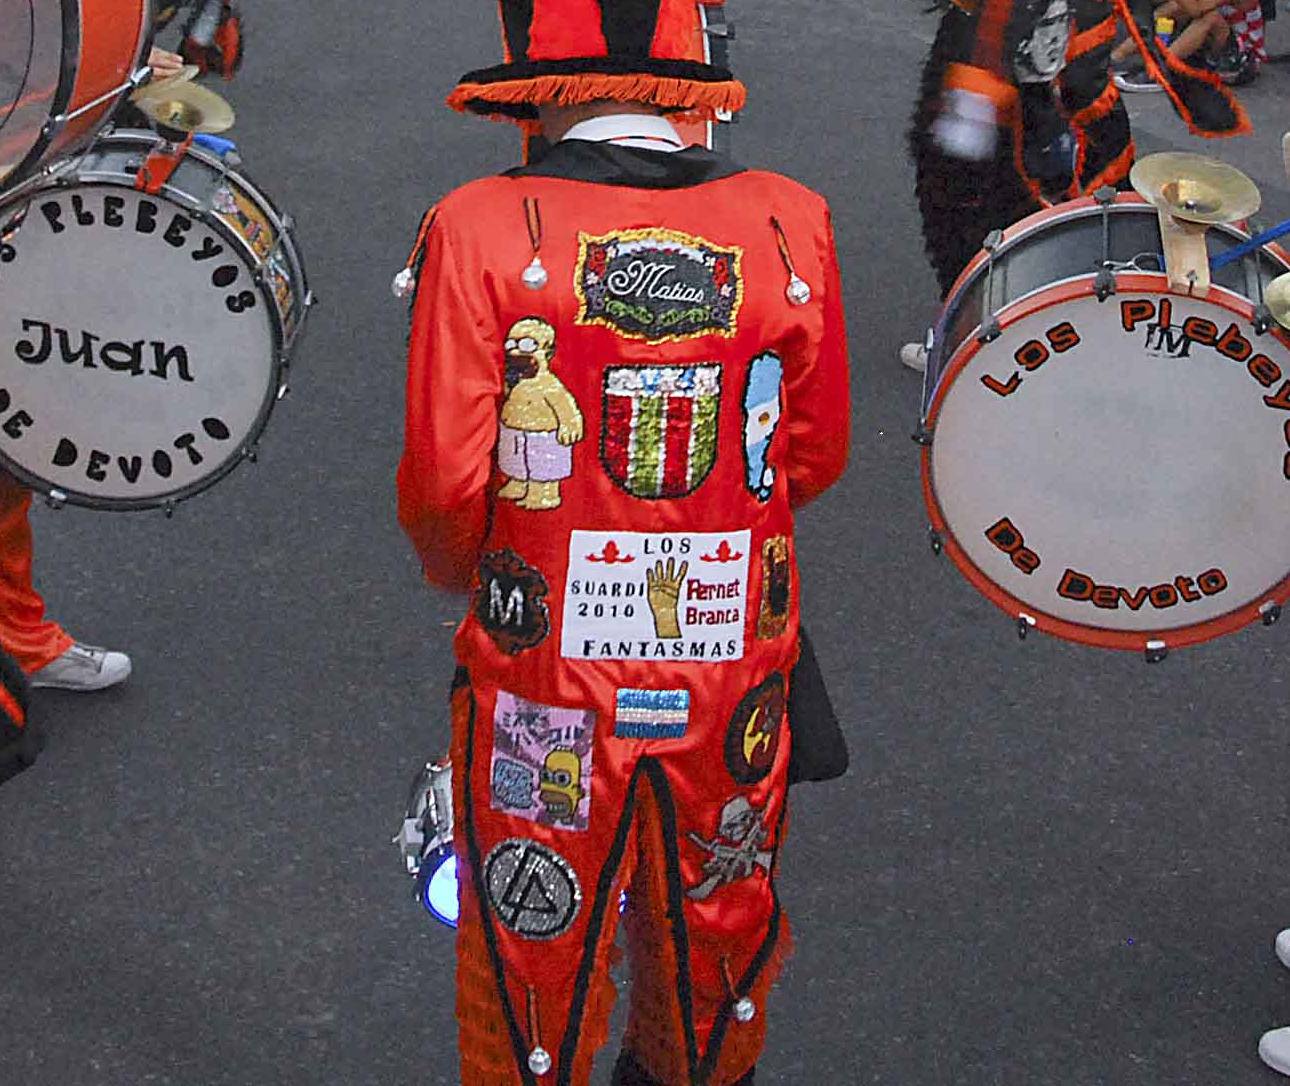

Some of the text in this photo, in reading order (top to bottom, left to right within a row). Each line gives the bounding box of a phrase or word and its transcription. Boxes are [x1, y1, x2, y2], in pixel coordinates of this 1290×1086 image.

[40, 194, 257, 314] PLEBEYOS
[14, 318, 194, 382] Juan
[980, 321, 1082, 397] Los
[51, 417, 231, 483] DEVOTO
[643, 538, 692, 555] LOS
[984, 516, 1229, 611] De Devoto
[570, 580, 645, 597] SUARDI
[577, 602, 635, 618] 2010
[685, 606, 740, 626] Branca
[582, 639, 737, 658] FANTASMAS
